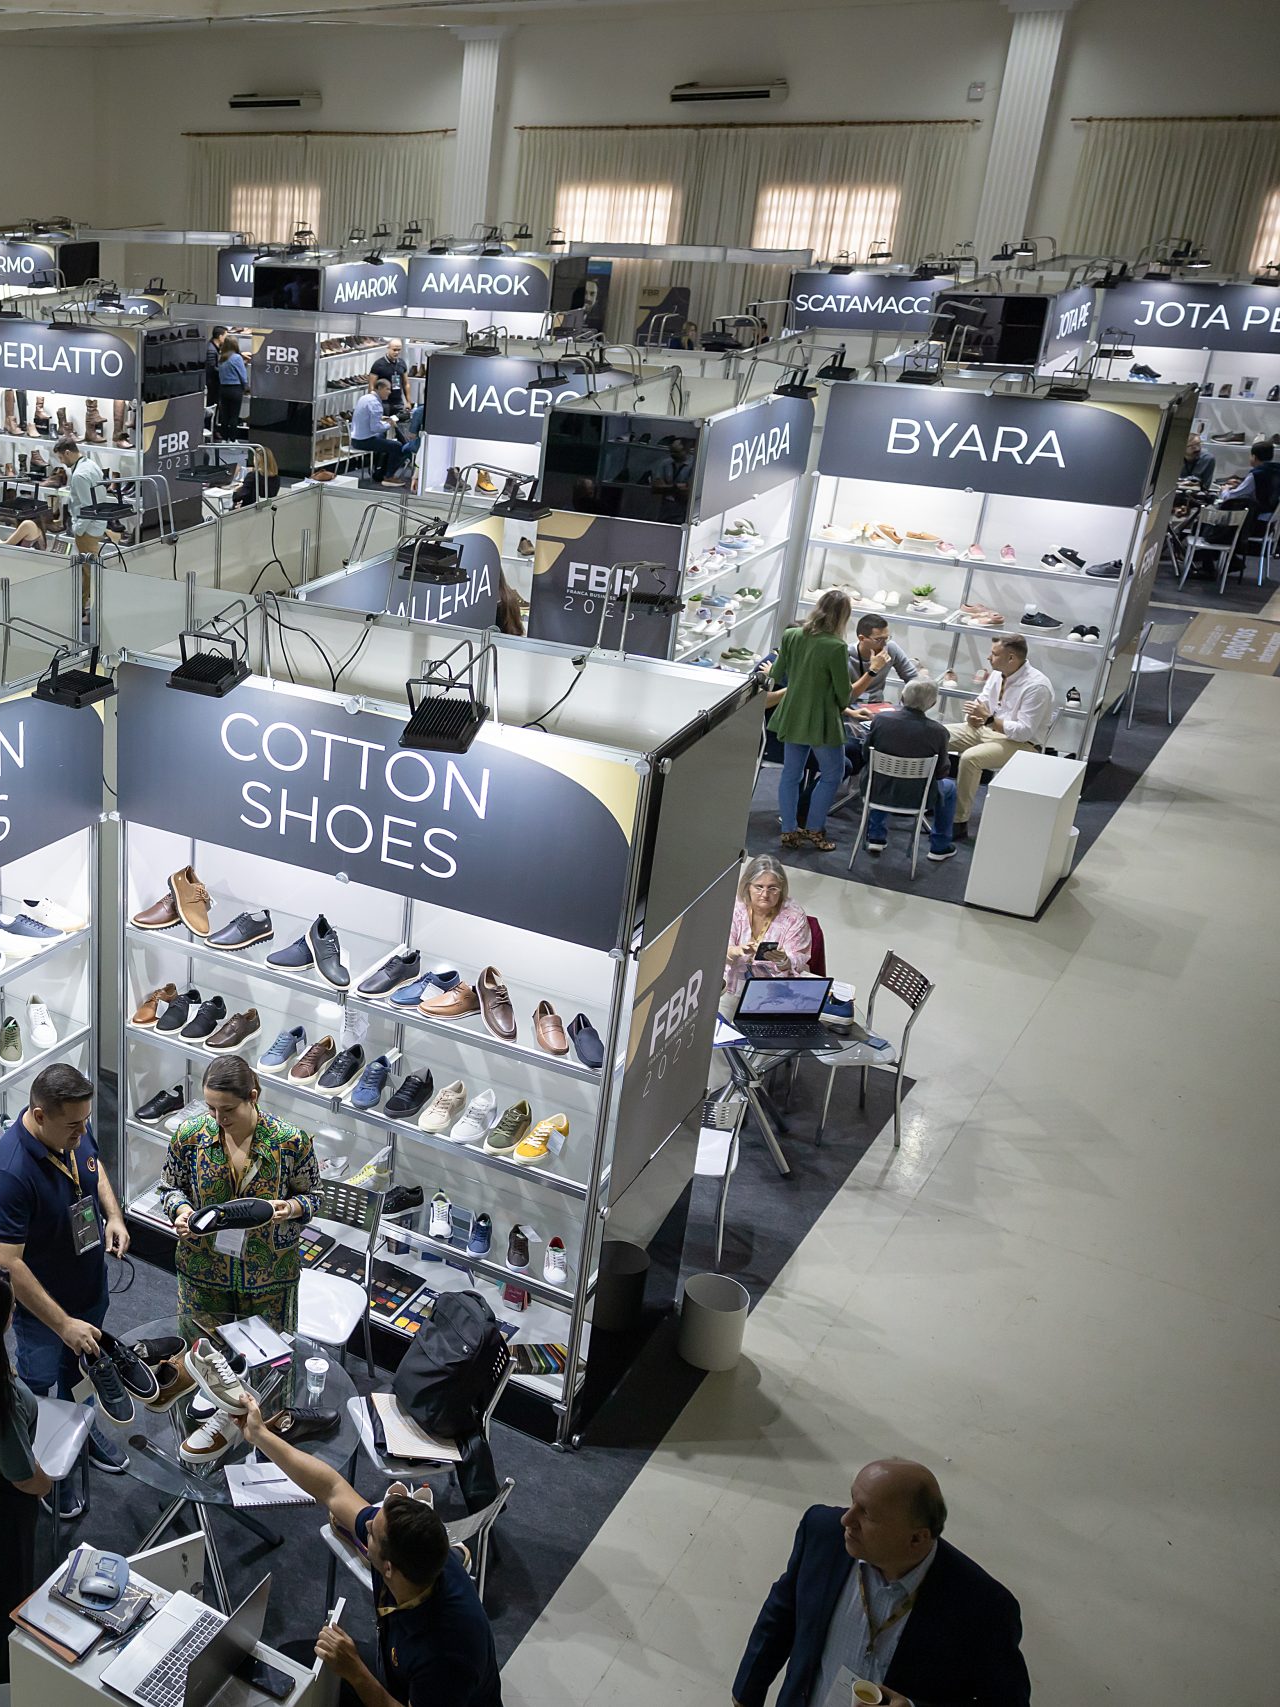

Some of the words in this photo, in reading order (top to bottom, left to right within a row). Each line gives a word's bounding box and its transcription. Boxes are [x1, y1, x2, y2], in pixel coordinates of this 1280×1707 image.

[334, 274, 398, 304] AMAROK
[422, 272, 531, 296] AMAROK
[1056, 307, 1079, 340] JOTA
[1077, 301, 1092, 330] PE
[1134, 300, 1230, 331] JOTA
[265, 364, 300, 376] 2023
[266, 345, 300, 363] FBR
[158, 430, 190, 456] FBR
[728, 422, 791, 482] BYARA
[885, 418, 1067, 469] BYARA
[157, 454, 190, 473] 2023
[566, 588, 589, 597] FRANCA
[589, 592, 617, 601] BUSINSS
[567, 561, 639, 597] FBR
[220, 711, 492, 820] COTTON
[239, 780, 458, 879] SHOES
[648, 969, 703, 1058] FBR
[642, 1023, 696, 1098] 2023
